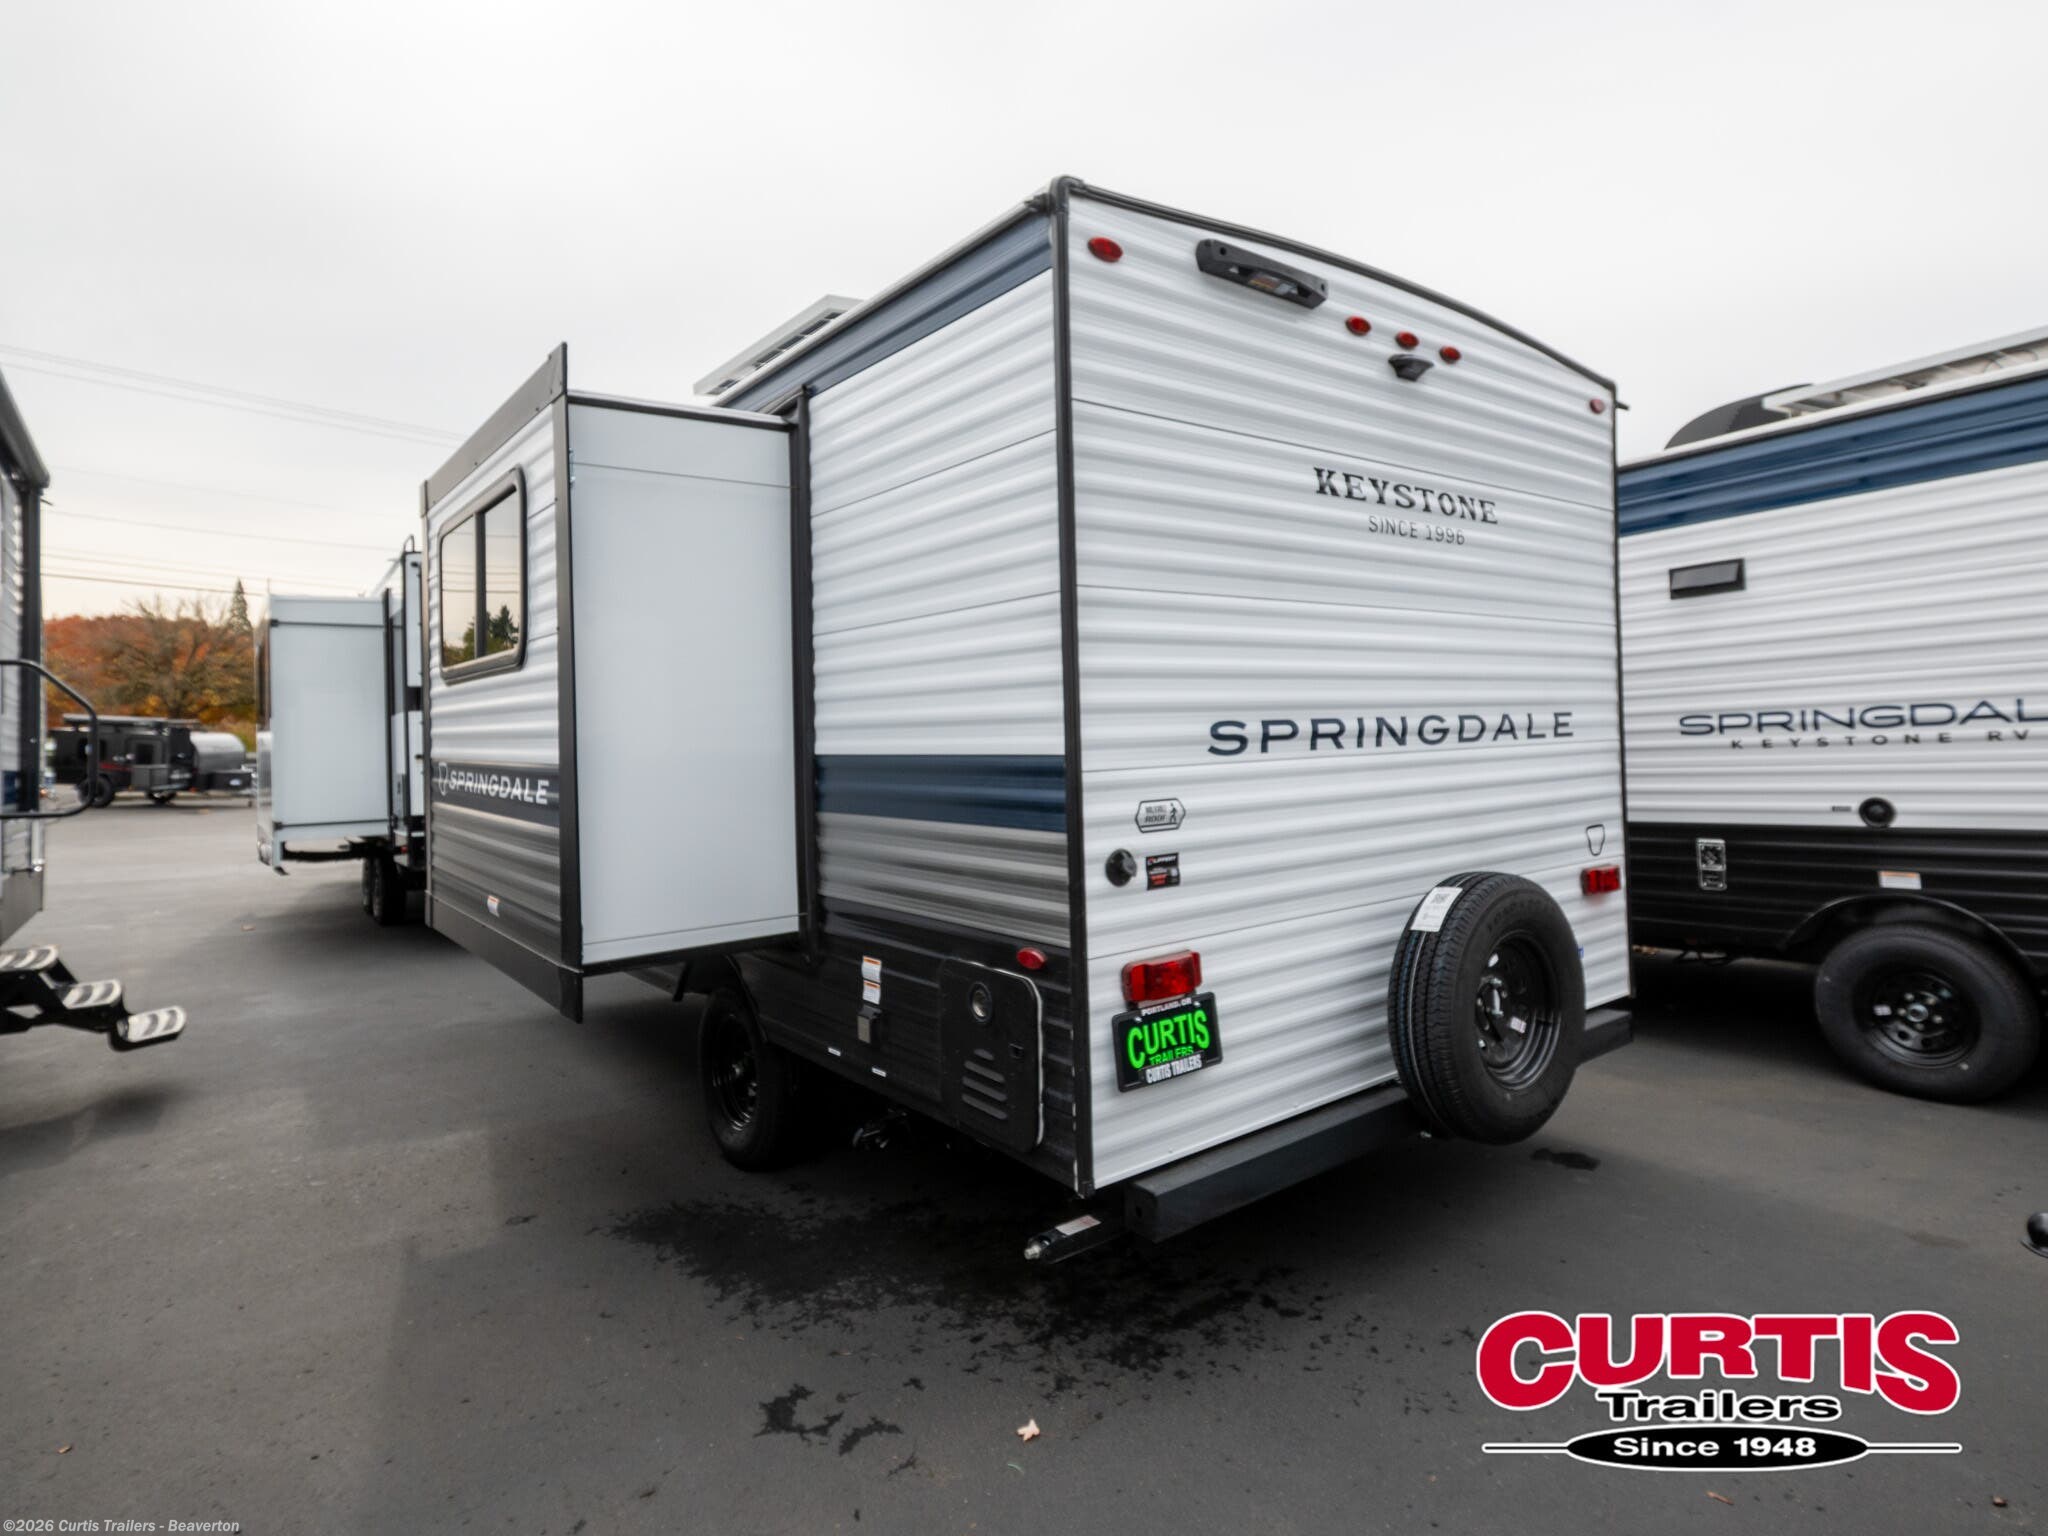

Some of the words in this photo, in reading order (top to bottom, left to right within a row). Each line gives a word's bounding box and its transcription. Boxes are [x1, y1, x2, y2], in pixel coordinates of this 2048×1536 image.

[1313, 467, 1498, 525] KEYSTONE
[1368, 515, 1419, 539] SINCE
[1425, 524, 1466, 545] 1996
[1208, 711, 1574, 756] SPRINGDALE
[1731, 729, 1953, 749] KEYSTONE
[1987, 730, 2029, 742] RV
[449, 770, 550, 805] SPRINGDALE
[1127, 1009, 1210, 1069] CURTIS
[1146, 1063, 1172, 1084] CURTIS
[1171, 1053, 1202, 1076] TRAILERS
